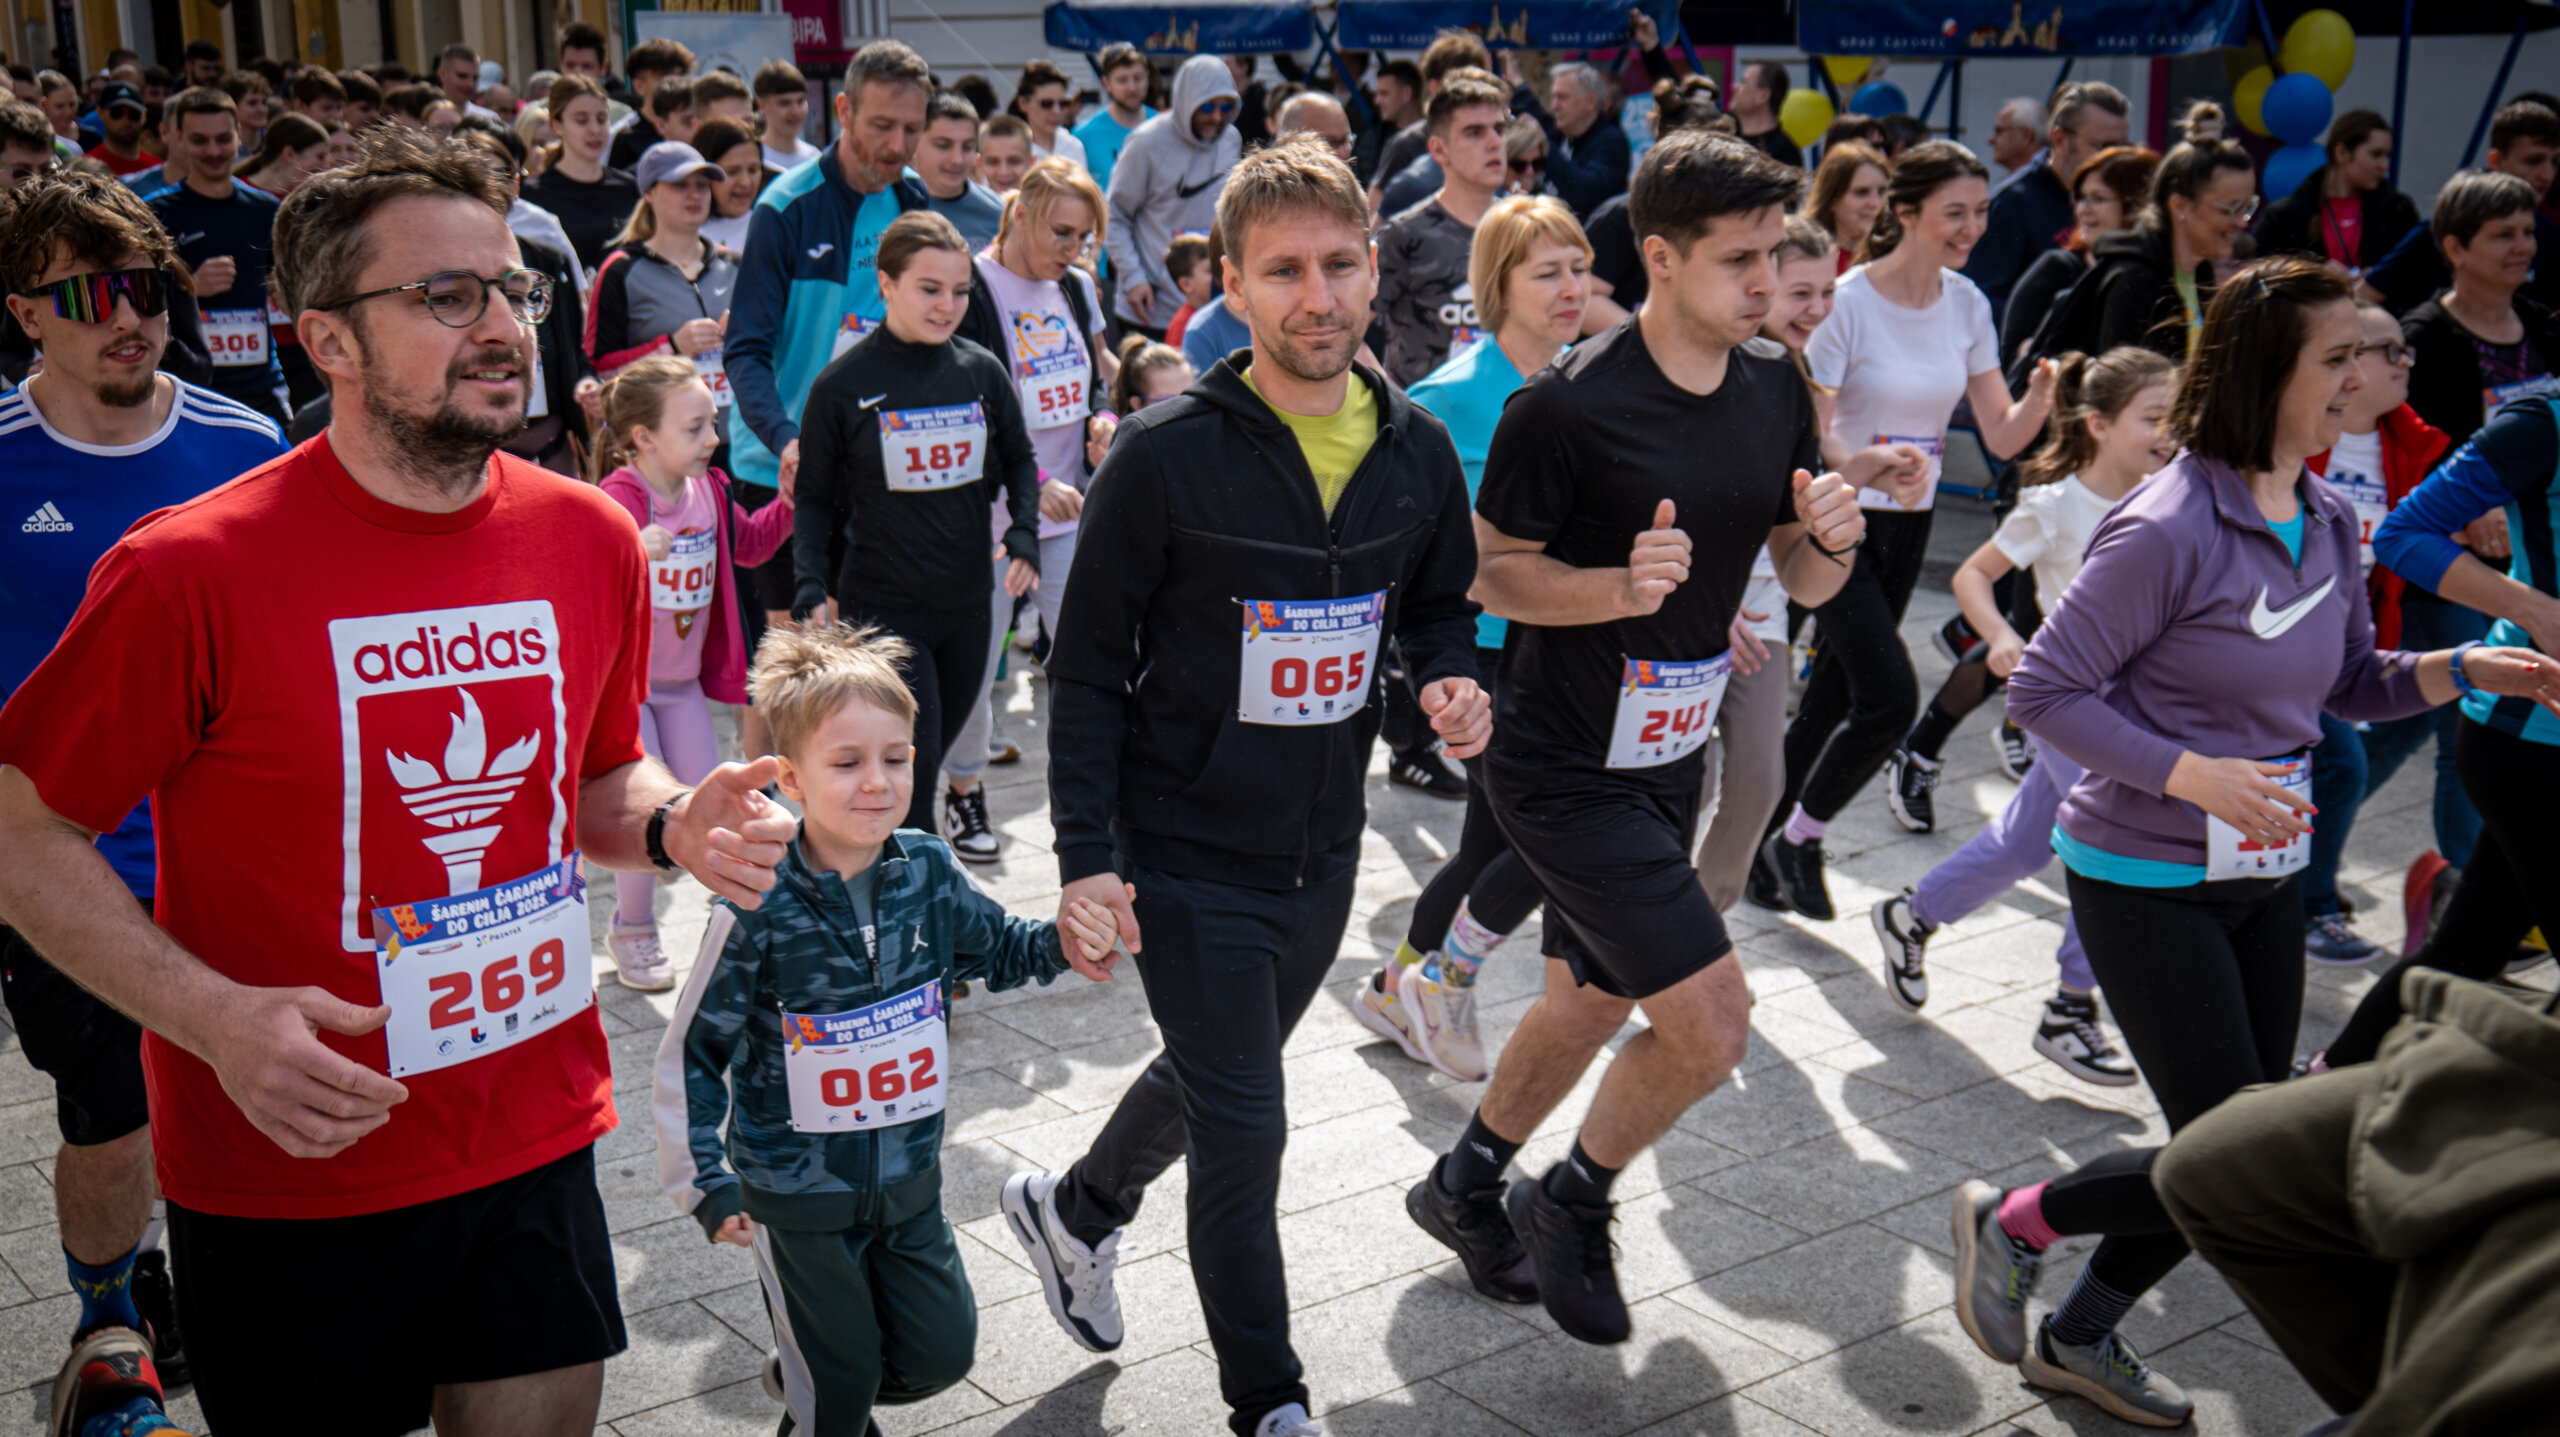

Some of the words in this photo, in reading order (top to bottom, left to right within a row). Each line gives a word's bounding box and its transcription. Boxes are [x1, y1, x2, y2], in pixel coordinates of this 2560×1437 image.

[208, 333, 260, 353] 306
[1038, 381, 1083, 413] 532
[905, 440, 972, 473] 187
[22, 520, 74, 533] adidas
[658, 561, 713, 592] 400
[1293, 619, 1308, 631] DO
[353, 622, 547, 684] adidas
[1271, 650, 1366, 699] 065
[1639, 698, 1710, 744] 241
[446, 918, 469, 936] DO
[473, 906, 512, 929] CILJA
[428, 938, 565, 1031] 269
[836, 1030, 854, 1043] DO
[857, 1022, 888, 1040] CILJA
[820, 1047, 939, 1107] 062
